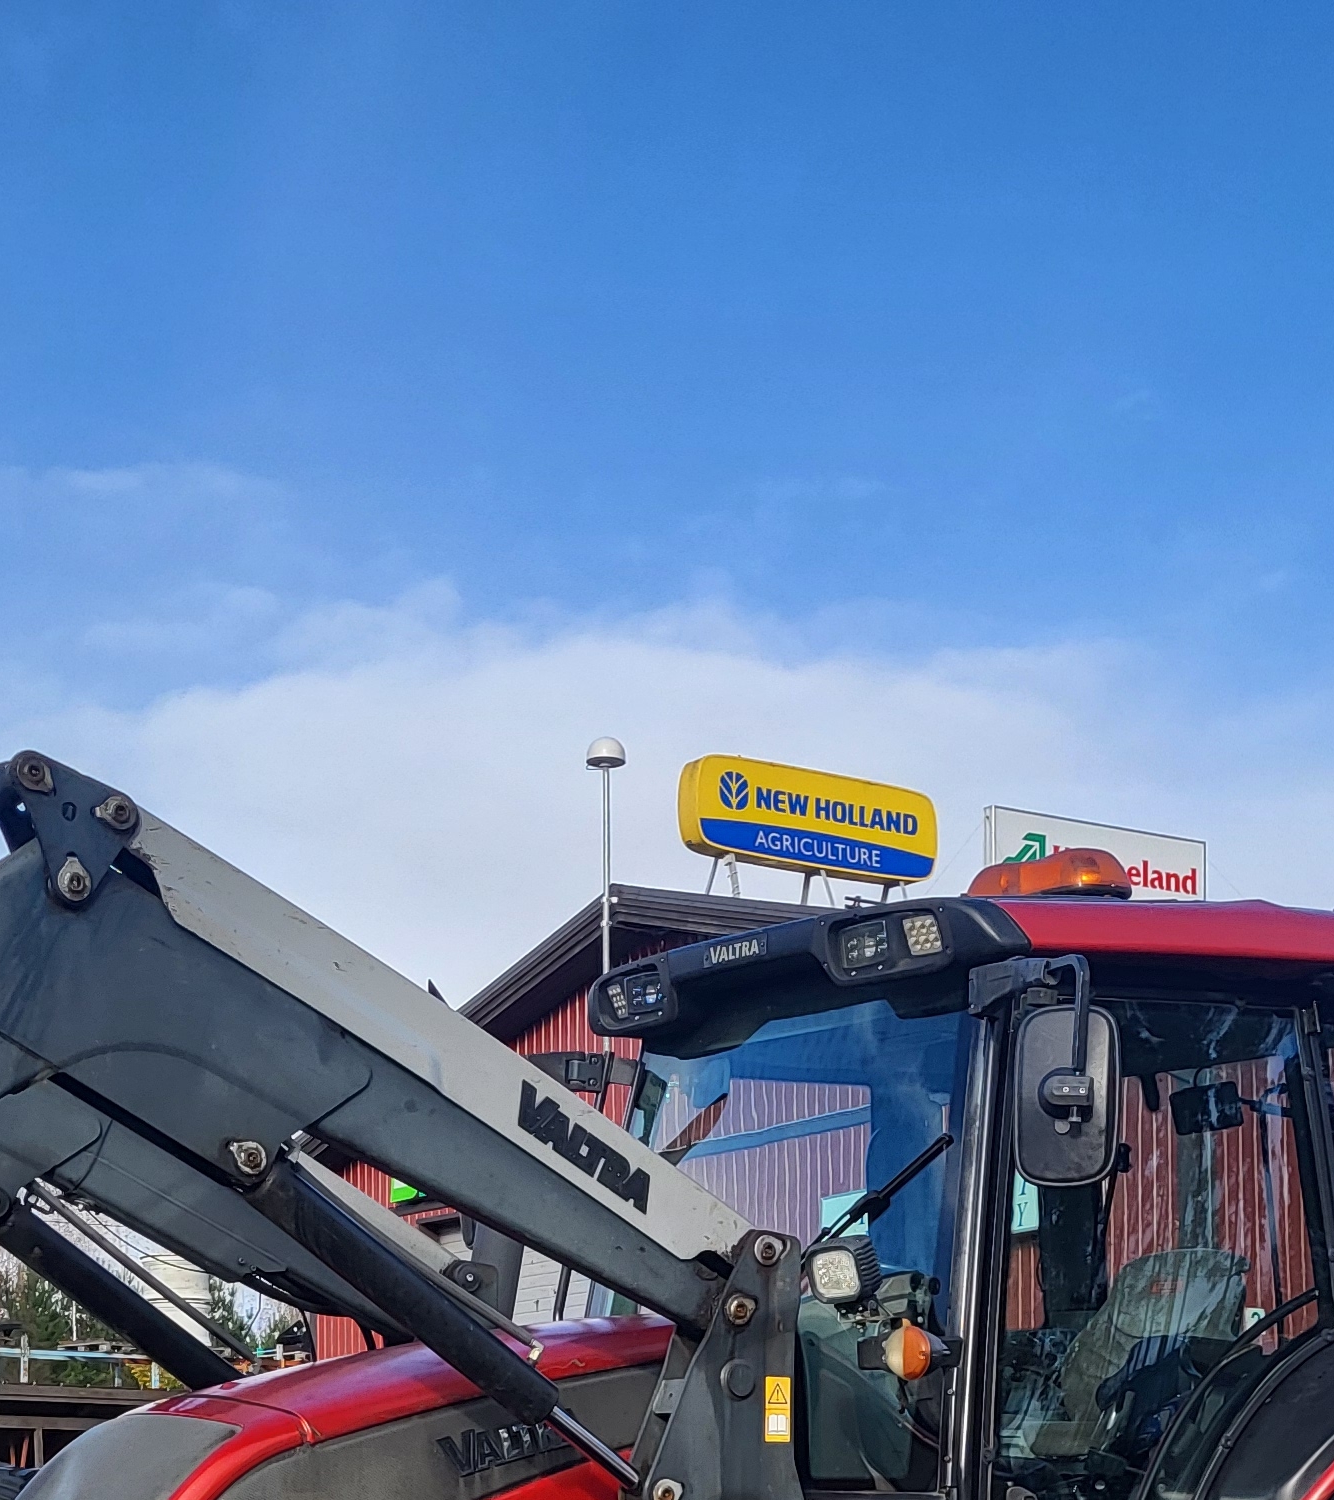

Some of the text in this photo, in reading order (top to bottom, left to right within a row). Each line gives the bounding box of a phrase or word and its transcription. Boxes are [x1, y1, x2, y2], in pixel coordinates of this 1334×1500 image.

[755, 787, 918, 836] NEW HOLLAND
[754, 830, 881, 868] AGRICULTURE
[709, 938, 760, 965] VALTRA
[518, 1079, 651, 1215] VALTRA
[435, 1410, 575, 1478] VALTR
